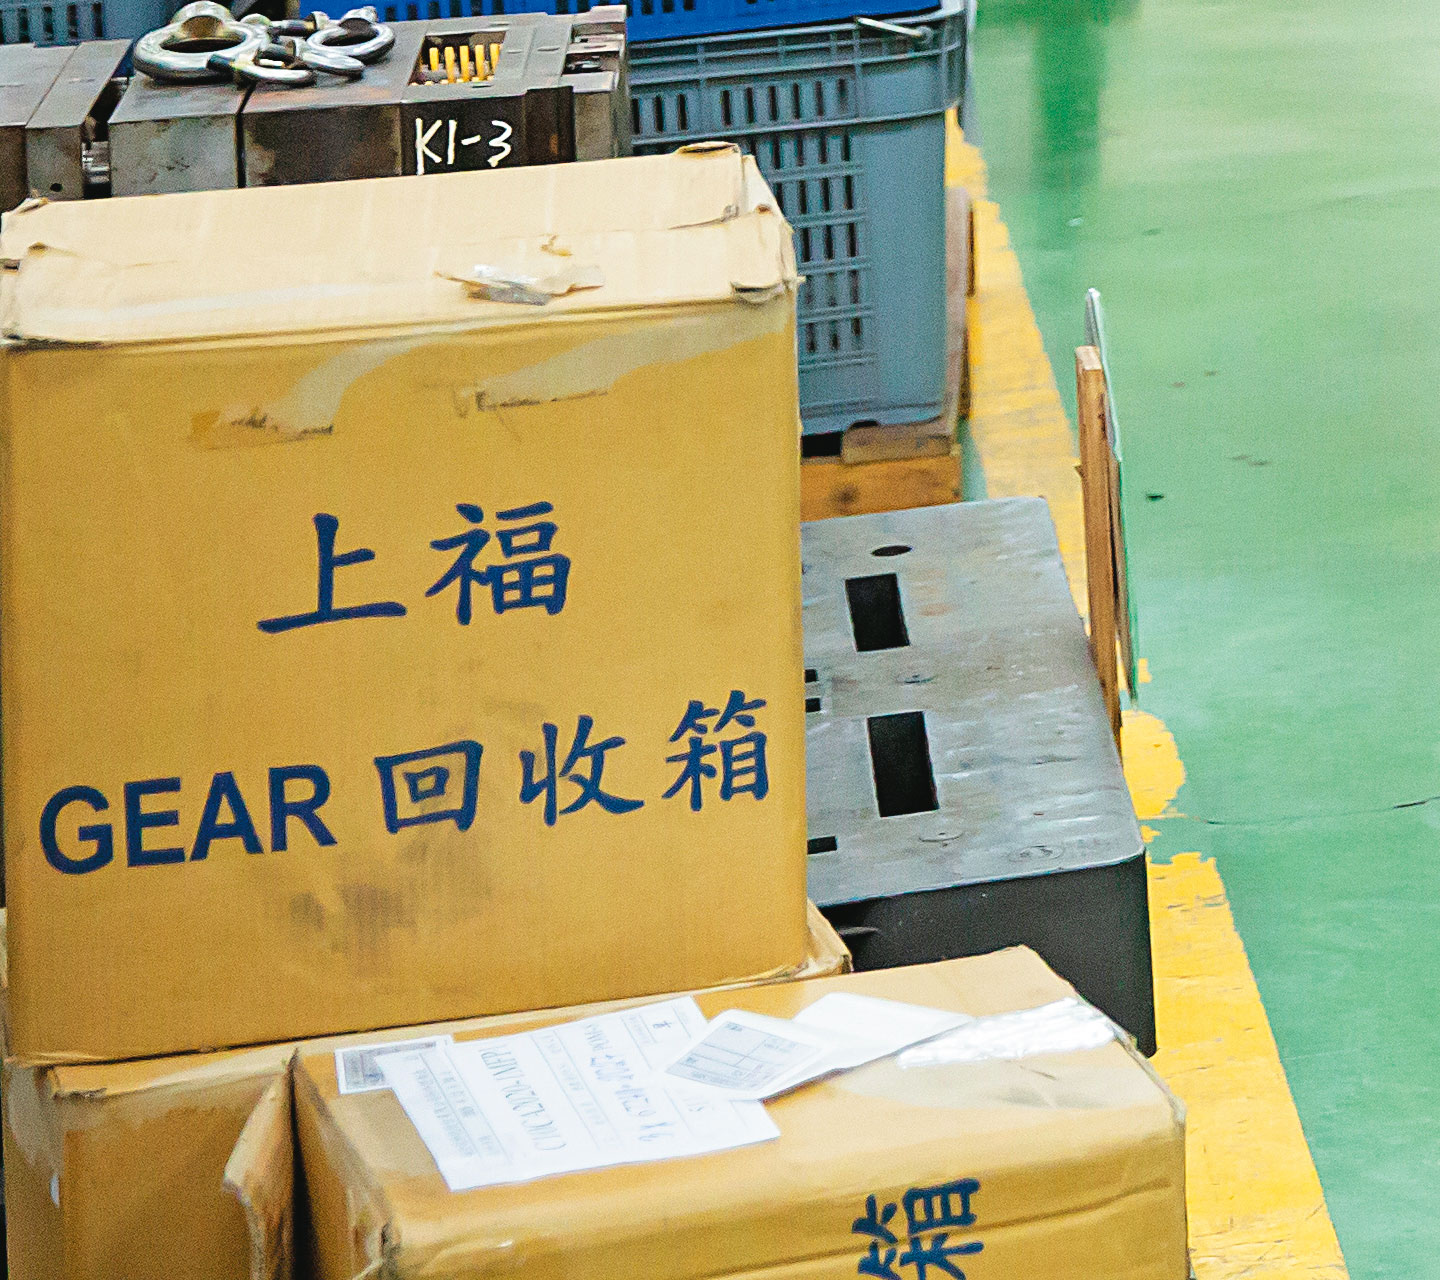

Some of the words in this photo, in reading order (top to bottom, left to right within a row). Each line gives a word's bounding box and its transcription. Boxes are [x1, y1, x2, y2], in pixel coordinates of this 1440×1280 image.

[257, 501, 571, 634] 上福
[38, 764, 337, 875] GEAR
[374, 690, 771, 835] 回收箱
